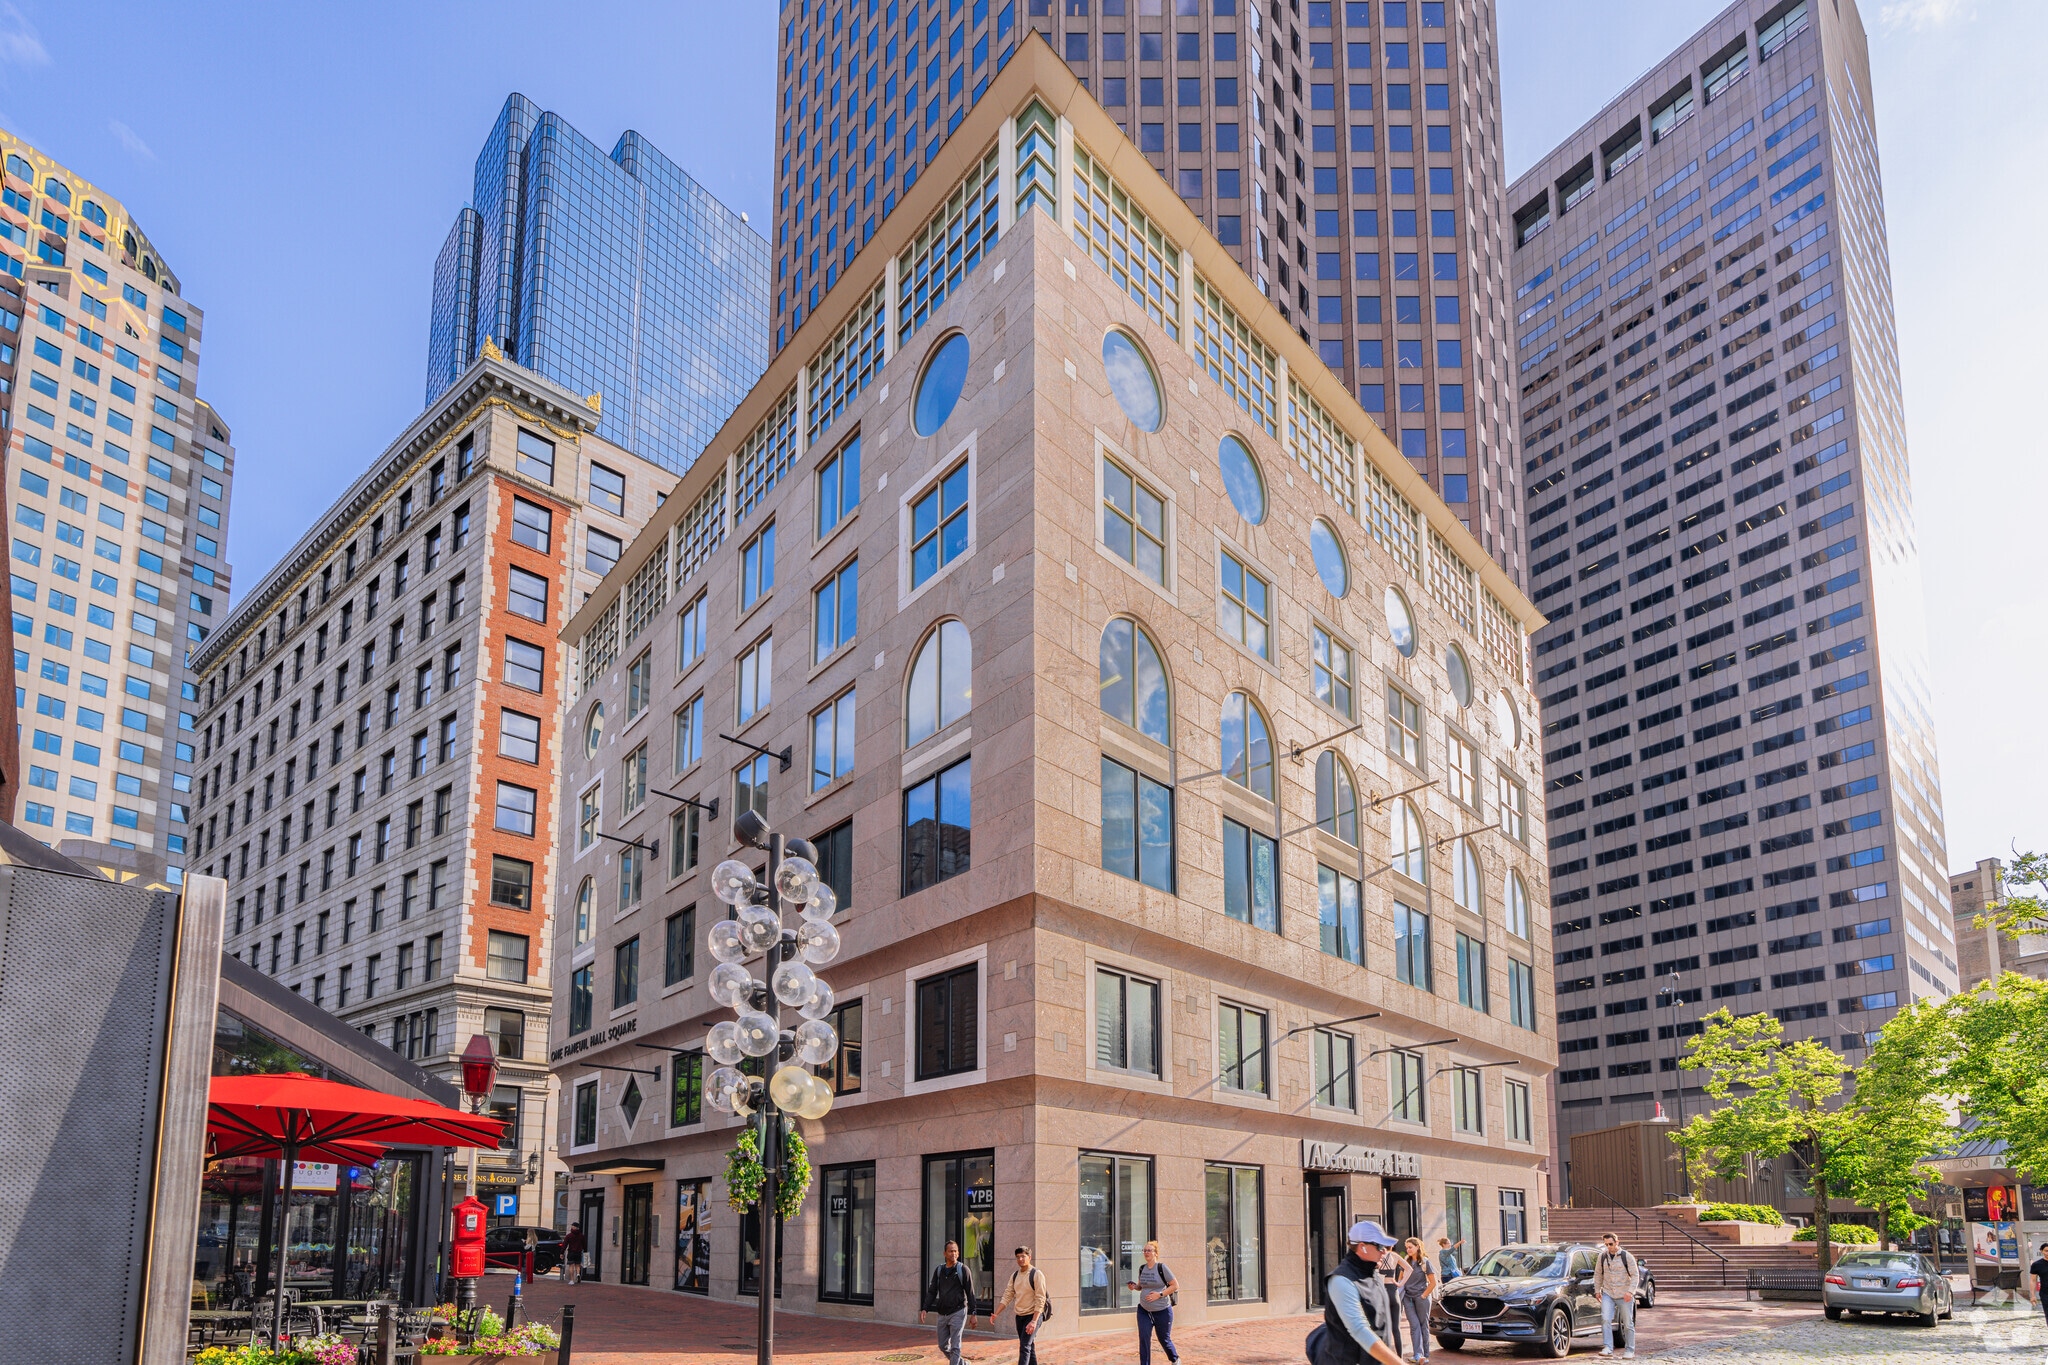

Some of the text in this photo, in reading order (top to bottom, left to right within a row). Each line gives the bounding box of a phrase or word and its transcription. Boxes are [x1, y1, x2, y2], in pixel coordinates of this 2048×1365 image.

[551, 1018, 638, 1062] ONE FANEUIL HALL SQUARE
[1310, 1143, 1420, 1178] Abercrombie & Fitch
[496, 1175, 517, 1184] GOLD
[500, 1196, 514, 1214] P
[971, 1190, 993, 1203] YPB
